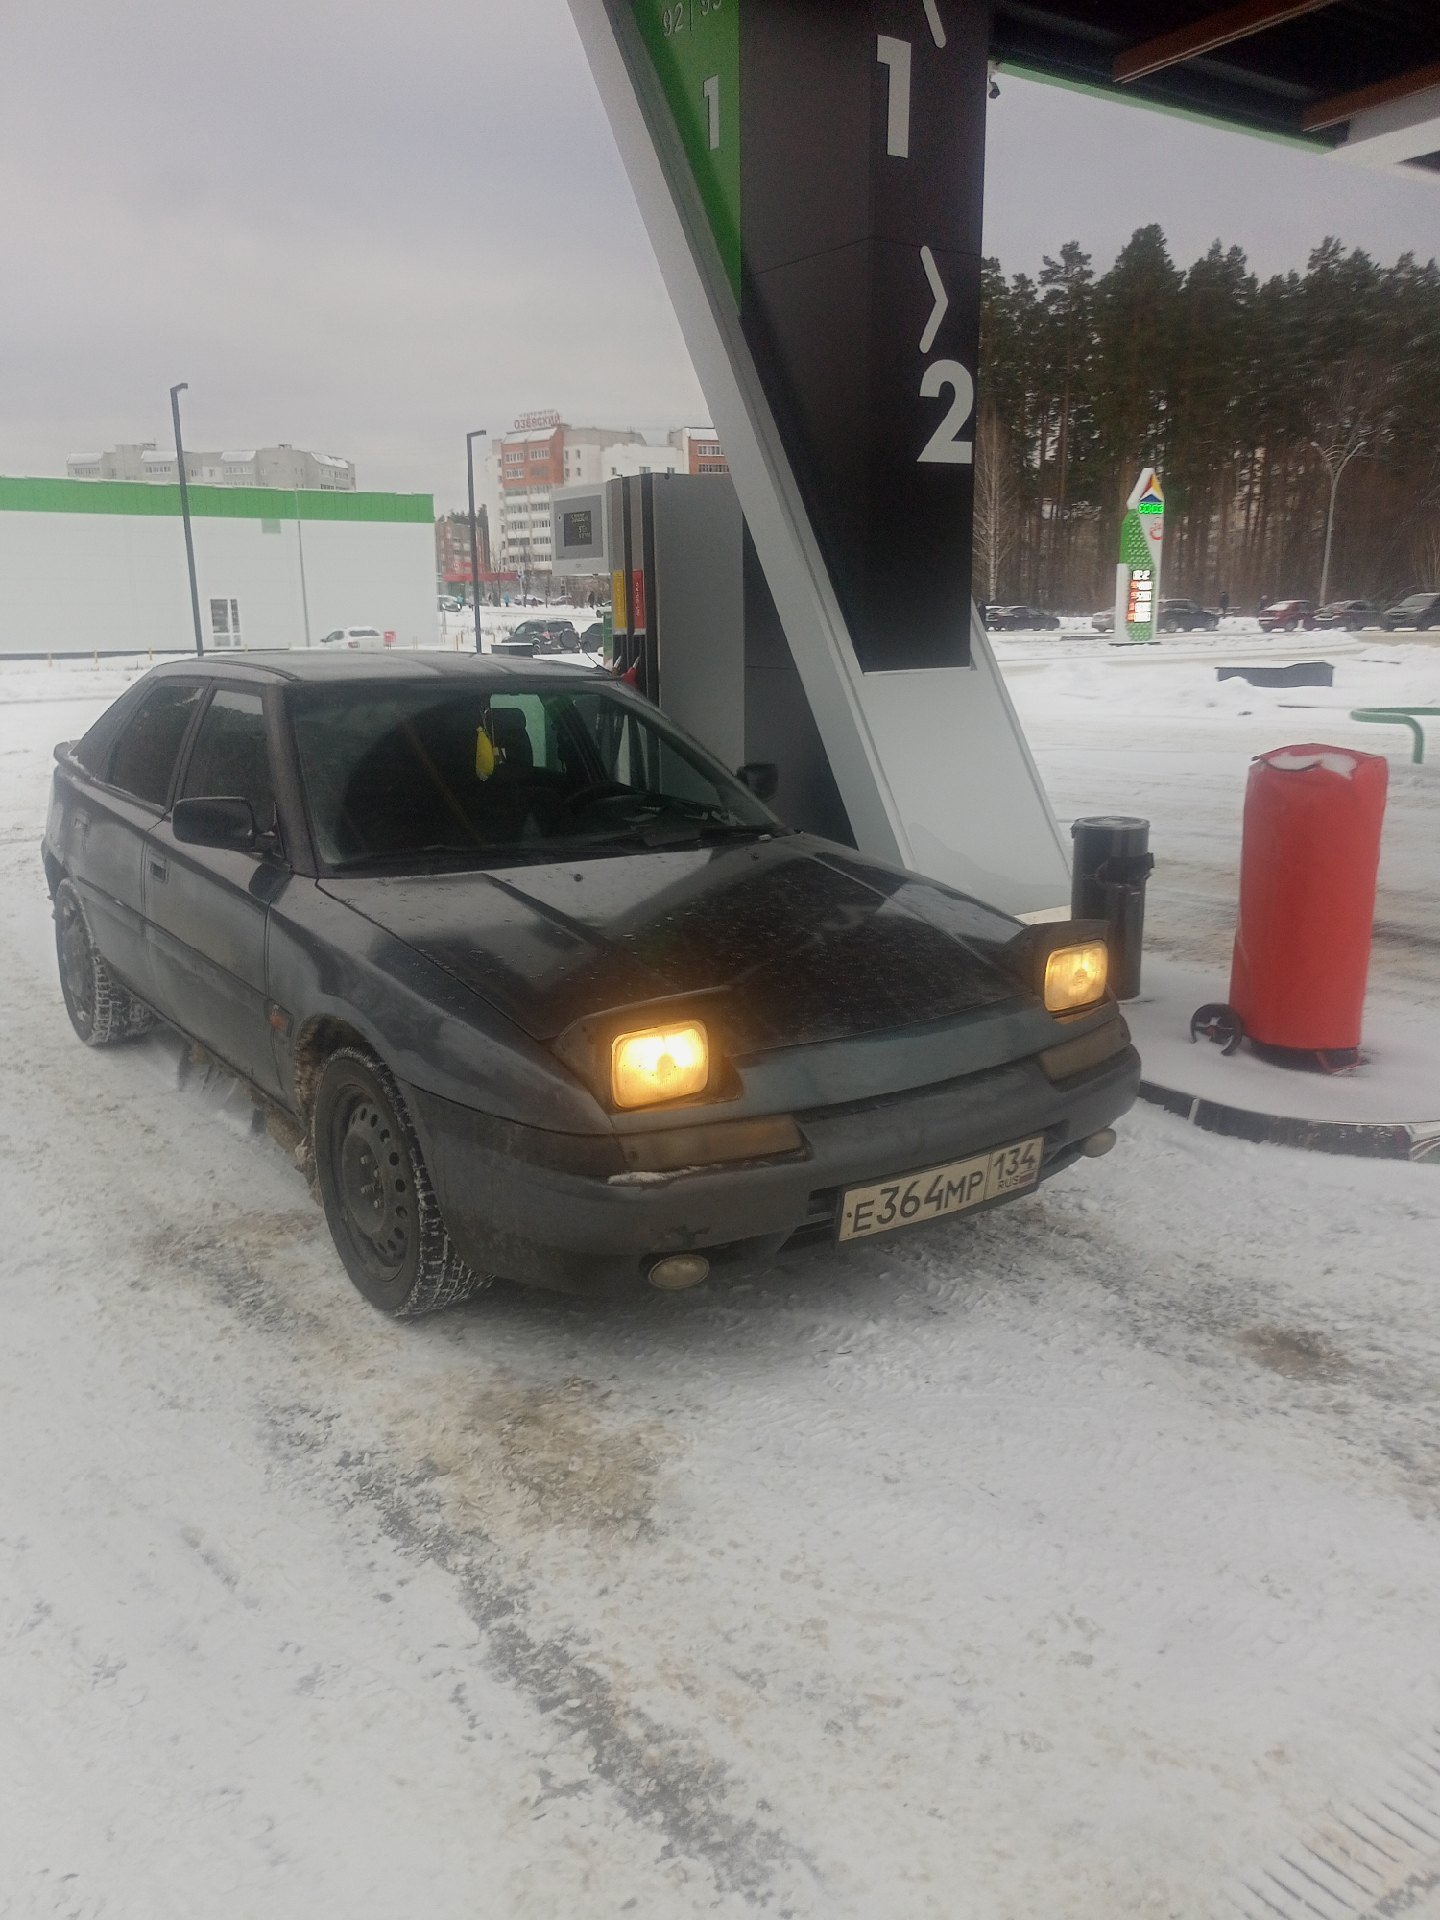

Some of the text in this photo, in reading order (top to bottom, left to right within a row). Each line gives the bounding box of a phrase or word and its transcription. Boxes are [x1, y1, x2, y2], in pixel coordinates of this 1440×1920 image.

[703, 74, 720, 151] 1
[876, 34, 912, 159] 1
[916, 359, 974, 464] 2
[993, 1142, 1036, 1180] 134
